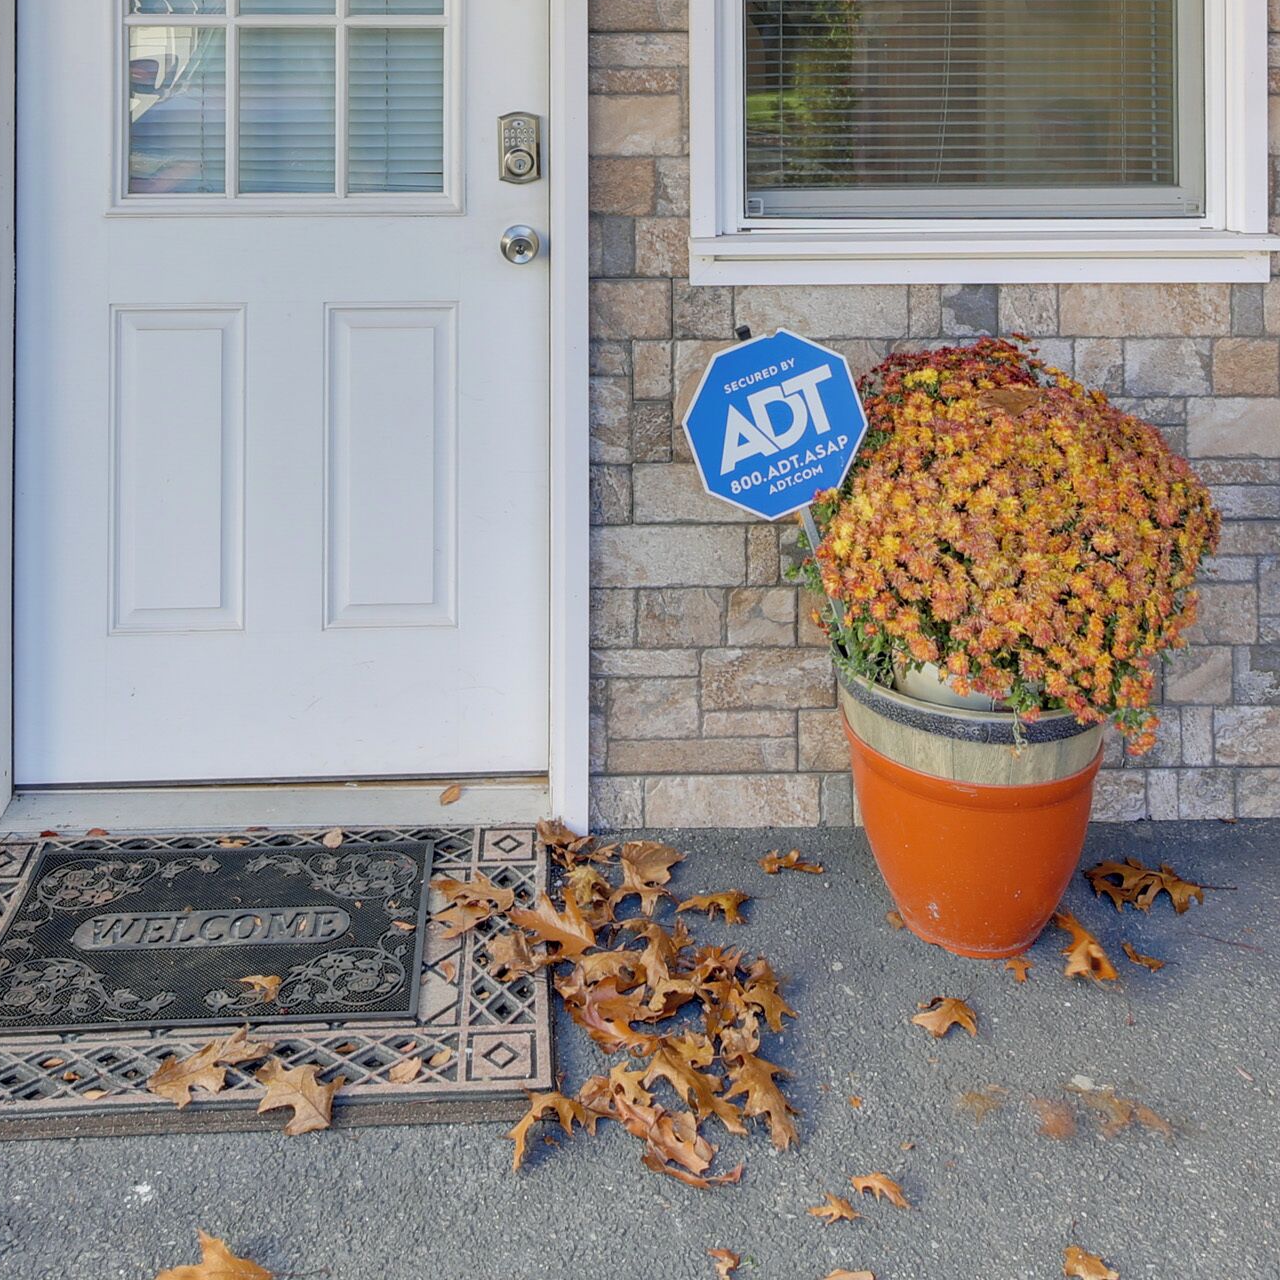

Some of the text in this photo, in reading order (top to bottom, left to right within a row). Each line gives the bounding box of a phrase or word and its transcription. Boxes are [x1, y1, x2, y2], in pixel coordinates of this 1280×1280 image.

[723, 358, 796, 394] SECURED BY
[720, 363, 832, 476] ADT
[730, 434, 848, 494] 800.ADT.ASAP
[768, 465, 823, 495] ADT.COM
[91, 910, 341, 946] WELCOME
